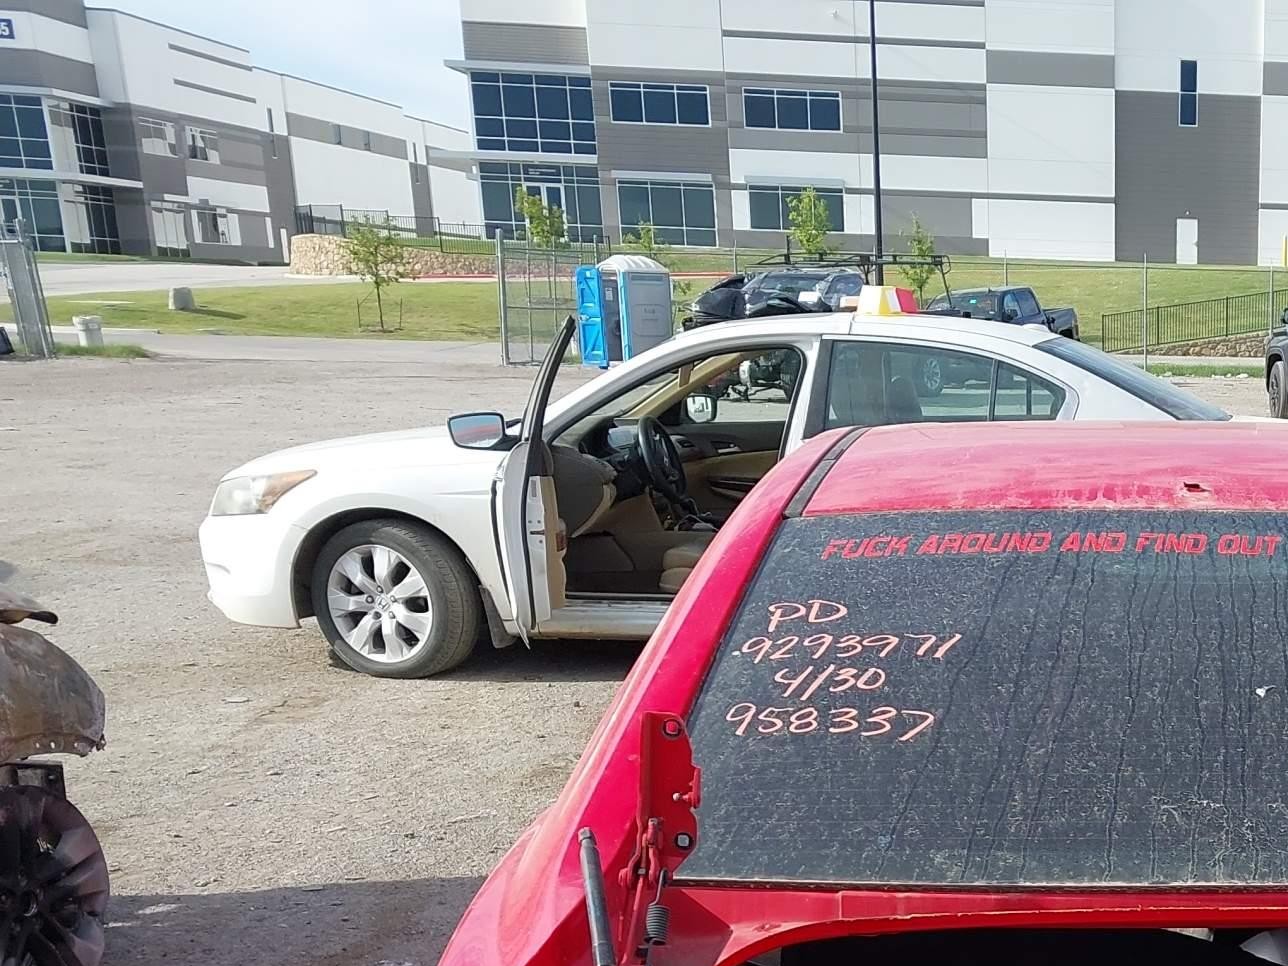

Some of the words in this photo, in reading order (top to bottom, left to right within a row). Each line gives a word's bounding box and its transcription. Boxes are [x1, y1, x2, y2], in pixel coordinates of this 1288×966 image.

[0, 21, 10, 36] 5
[820, 534, 913, 561] FUCK
[915, 531, 1052, 556] AROUND
[1058, 532, 1127, 553] AND
[1135, 532, 1207, 554] FIND
[1217, 534, 1282, 556] OUT
[767, 599, 848, 633] PD
[741, 633, 962, 664] 9293971
[774, 664, 886, 700] 4/30
[725, 703, 935, 741] 958337
